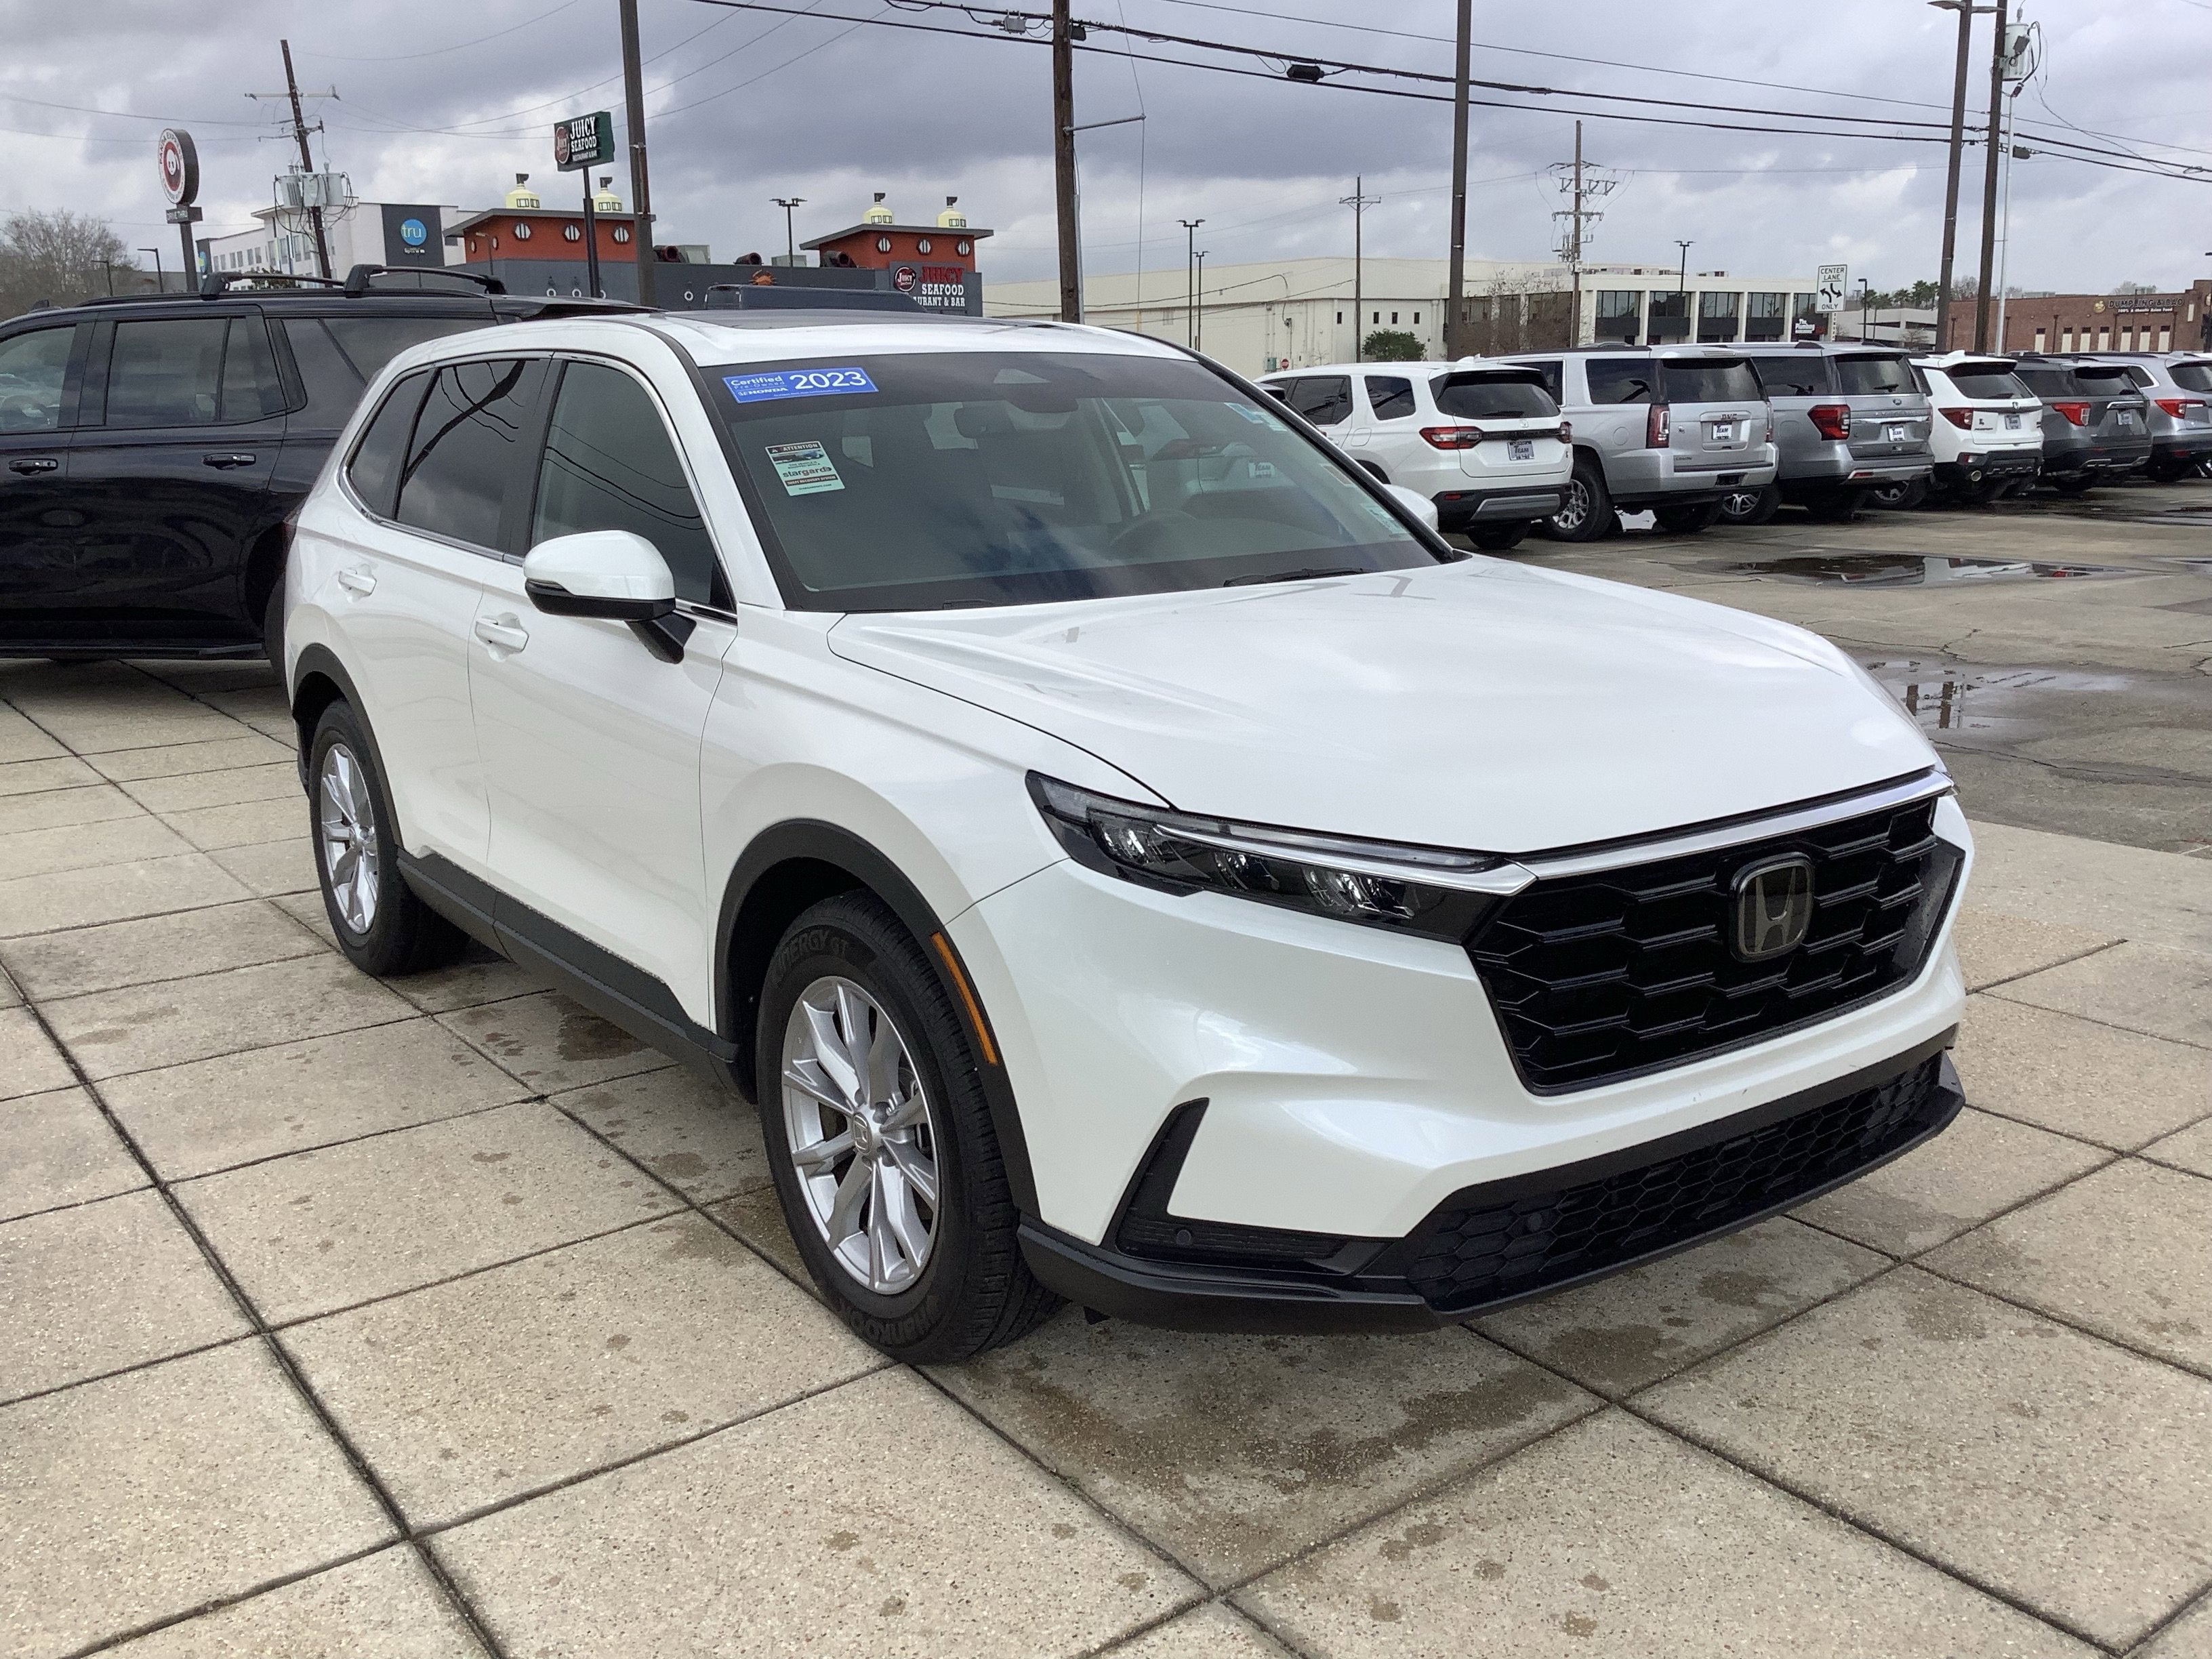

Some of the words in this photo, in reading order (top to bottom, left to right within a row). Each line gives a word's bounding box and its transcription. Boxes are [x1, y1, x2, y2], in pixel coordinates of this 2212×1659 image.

[570, 117, 595, 140] JUICY
[571, 136, 596, 152] SEAFOOD
[401, 224, 422, 239] tru
[918, 266, 964, 283] JUICY
[922, 283, 964, 295] SEAFOOD
[943, 297, 949, 306] &
[951, 297, 965, 307] BAR
[731, 375, 783, 386] Certified
[734, 382, 785, 390] Pre-Owned
[790, 371, 867, 390] 2023
[747, 387, 789, 395] HONDA
[1717, 424, 1729, 433] TEAM
[783, 443, 819, 451] ATTENTION
[1514, 445, 1529, 453] TEAM
